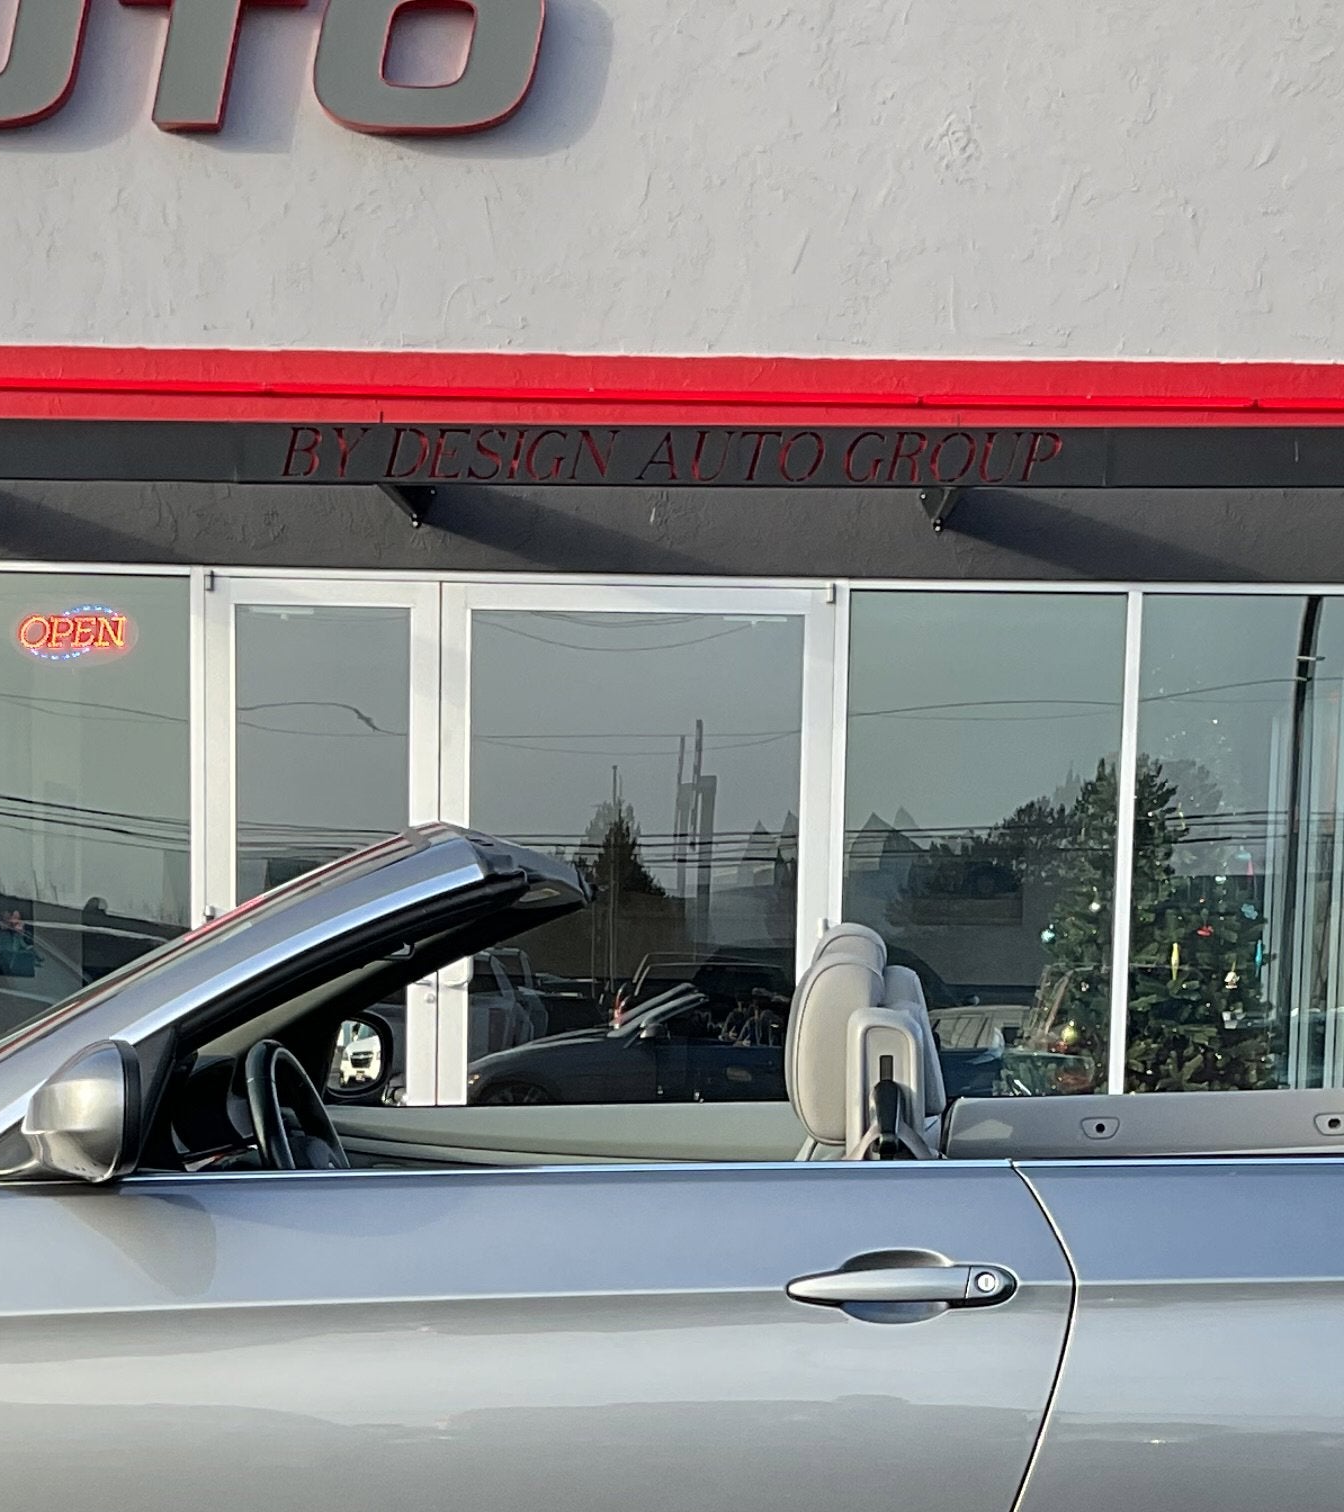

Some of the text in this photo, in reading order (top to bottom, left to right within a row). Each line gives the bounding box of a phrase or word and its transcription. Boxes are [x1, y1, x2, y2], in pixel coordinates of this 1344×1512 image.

[281, 426, 1063, 484] BY DESIGN AUTO GROUP
[18, 614, 127, 650] OPEN
